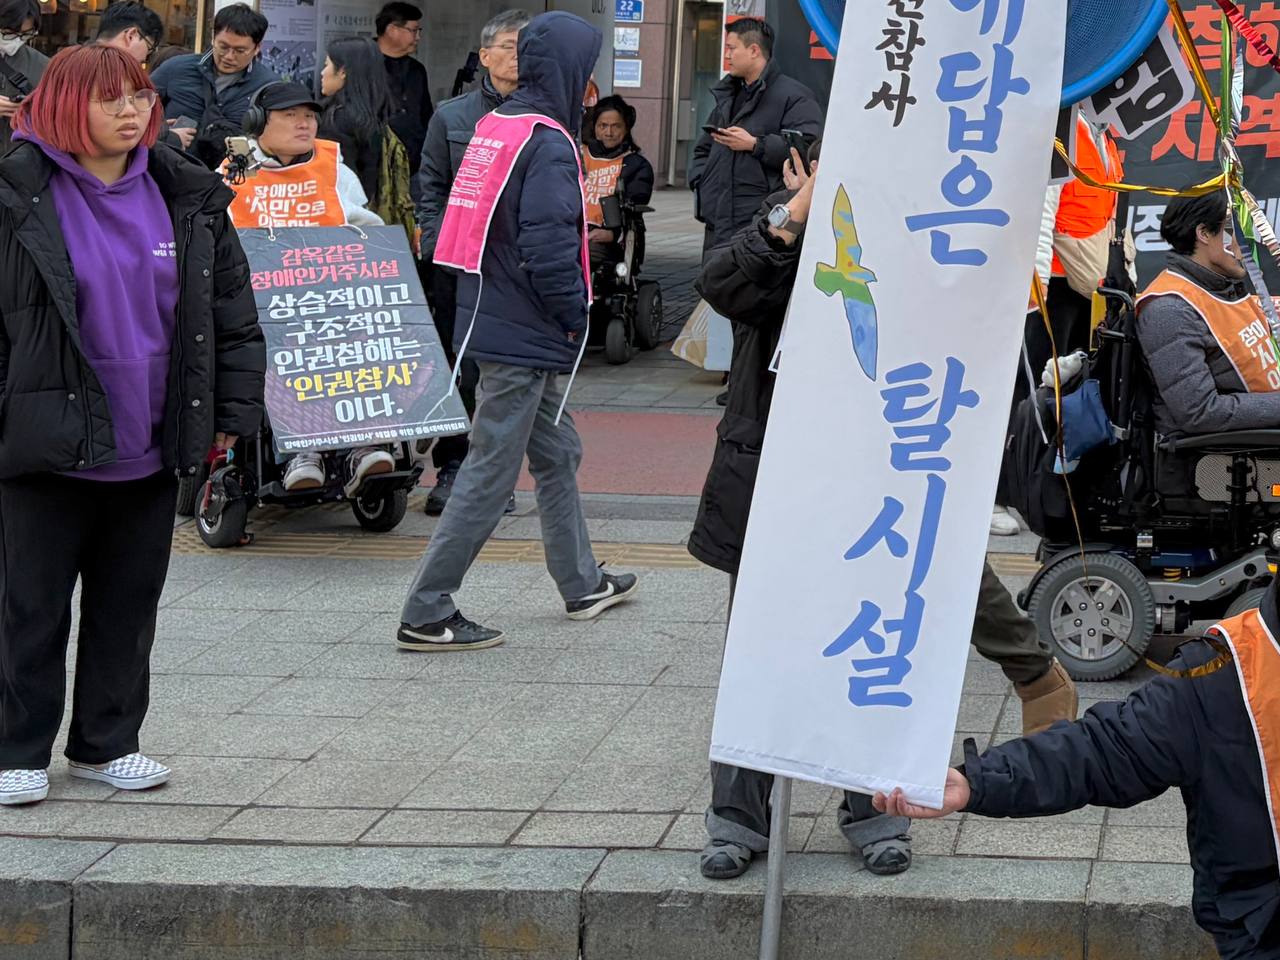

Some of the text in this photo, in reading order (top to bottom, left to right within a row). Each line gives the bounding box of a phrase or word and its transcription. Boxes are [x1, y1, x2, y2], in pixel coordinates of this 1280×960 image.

[620, 0, 634, 11] 22
[253, 179, 318, 200] 장애인도
[280, 242, 366, 268] 감옥같은
[250, 259, 401, 291] 장애인거주시설
[266, 282, 413, 320] 상습적이고
[285, 309, 403, 345] 구조적인
[273, 336, 422, 376] 인권침해는
[334, 392, 404, 424] 이다.
[822, 356, 980, 708] 탈시설
